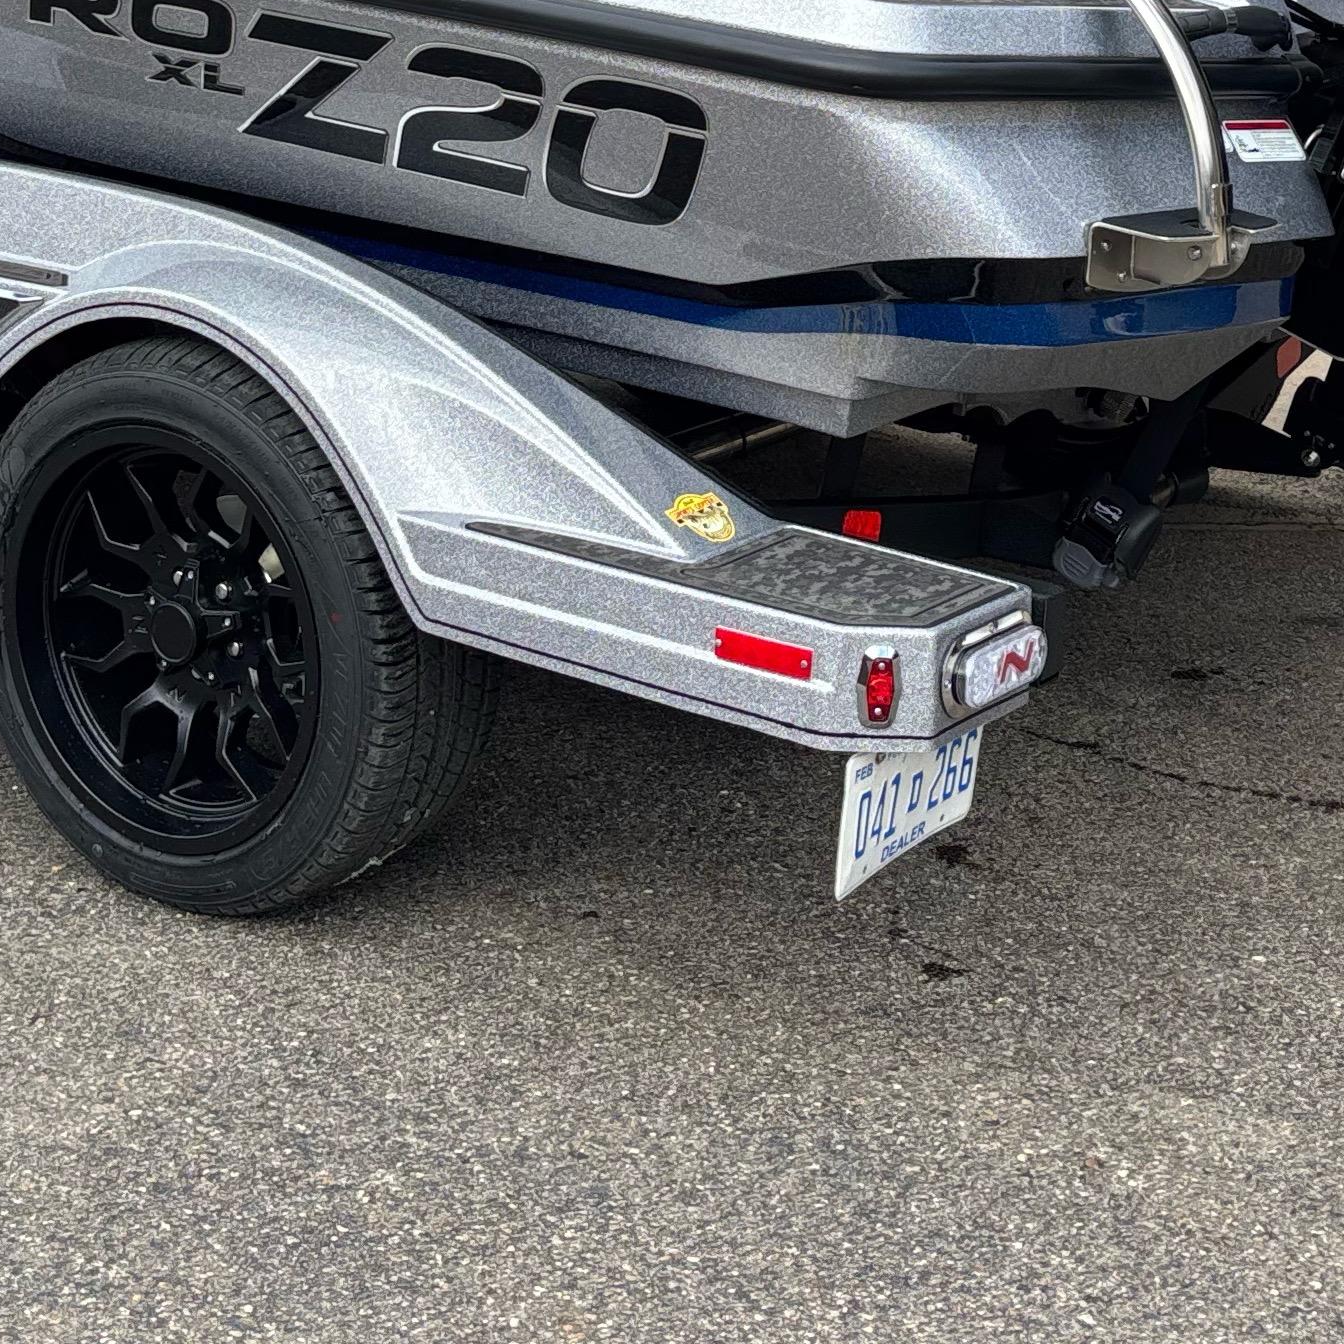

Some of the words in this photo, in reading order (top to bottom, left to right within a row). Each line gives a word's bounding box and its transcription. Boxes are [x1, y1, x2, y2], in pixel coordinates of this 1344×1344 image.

[149, 52, 247, 97] XL
[238, 8, 712, 228] Z20
[854, 762, 874, 784] FEB
[880, 820, 926, 863] DEALER
